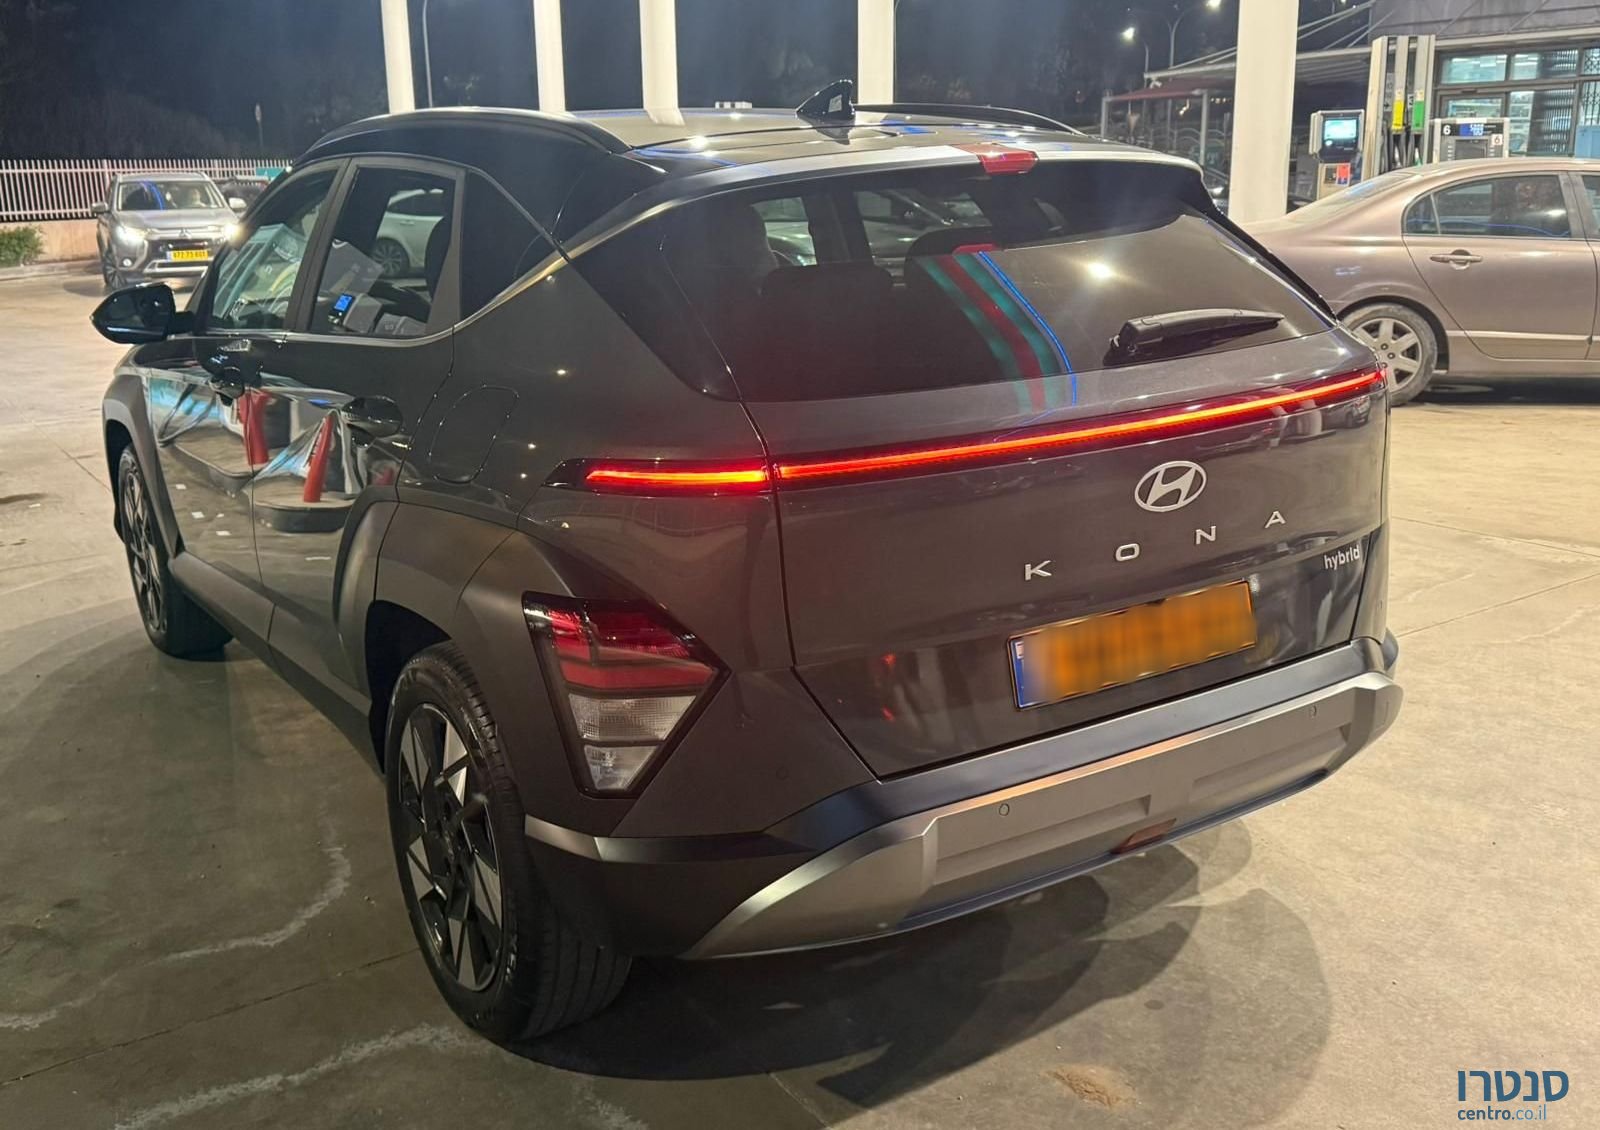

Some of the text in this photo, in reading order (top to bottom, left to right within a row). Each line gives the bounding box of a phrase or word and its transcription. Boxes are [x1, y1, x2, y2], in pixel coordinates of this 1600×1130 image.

[1443, 125, 1451, 135] 6
[1024, 510, 1286, 581] KONA
[1323, 544, 1360, 570] hybrid
